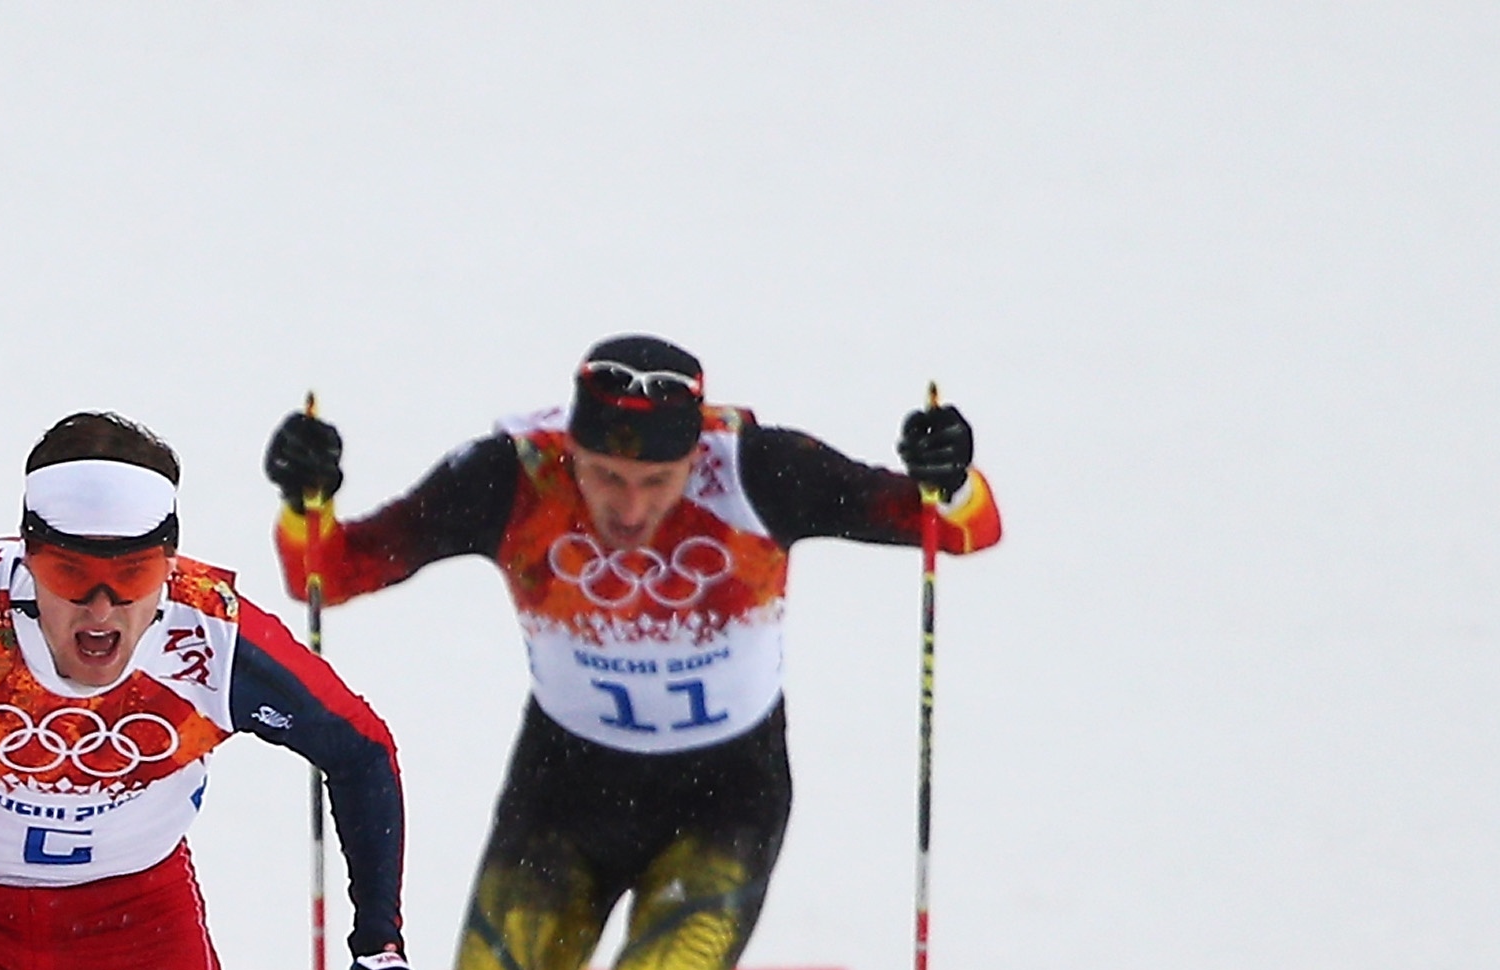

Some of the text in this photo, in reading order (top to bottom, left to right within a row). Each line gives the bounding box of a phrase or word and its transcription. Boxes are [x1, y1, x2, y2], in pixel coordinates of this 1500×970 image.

[574, 648, 730, 674] SOCHI 2014
[590, 678, 728, 733] 11
